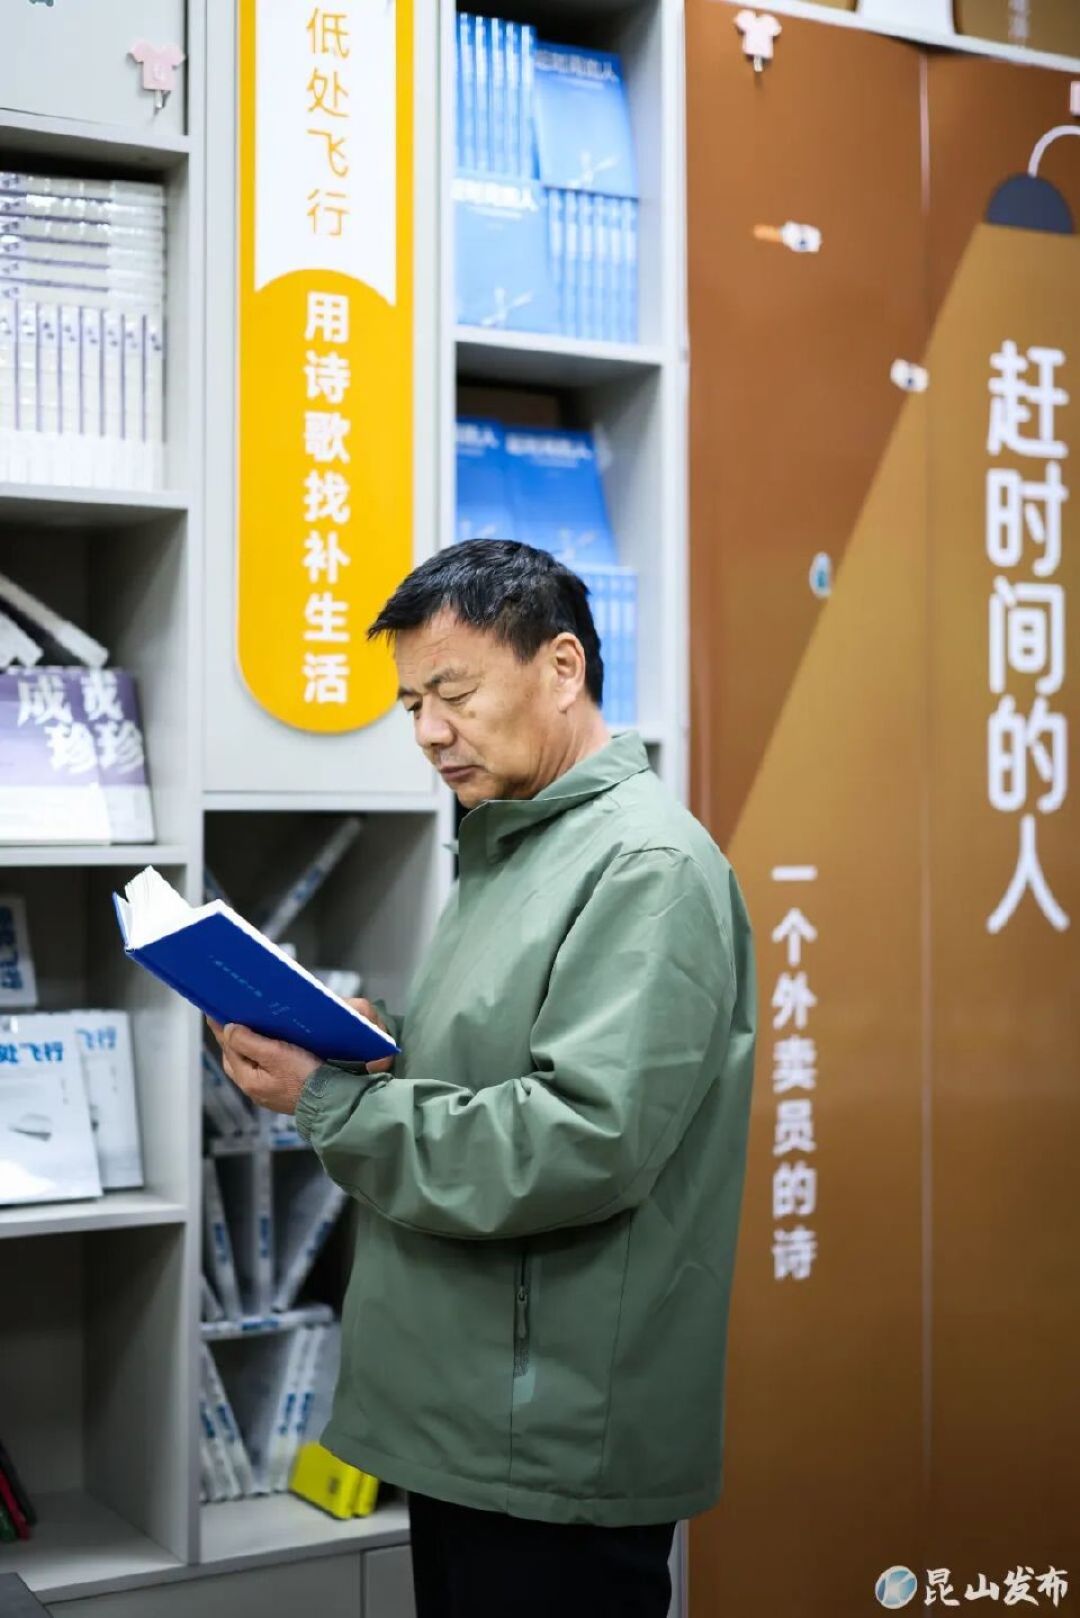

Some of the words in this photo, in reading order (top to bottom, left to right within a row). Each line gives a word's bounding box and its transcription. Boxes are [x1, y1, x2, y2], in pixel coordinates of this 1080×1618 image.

[305, 8, 350, 237] 低处飞行
[303, 291, 351, 704] 用诗歌找补生活
[986, 340, 1069, 934] 赶时间的人
[771, 865, 818, 1281] 一个外卖员的诗
